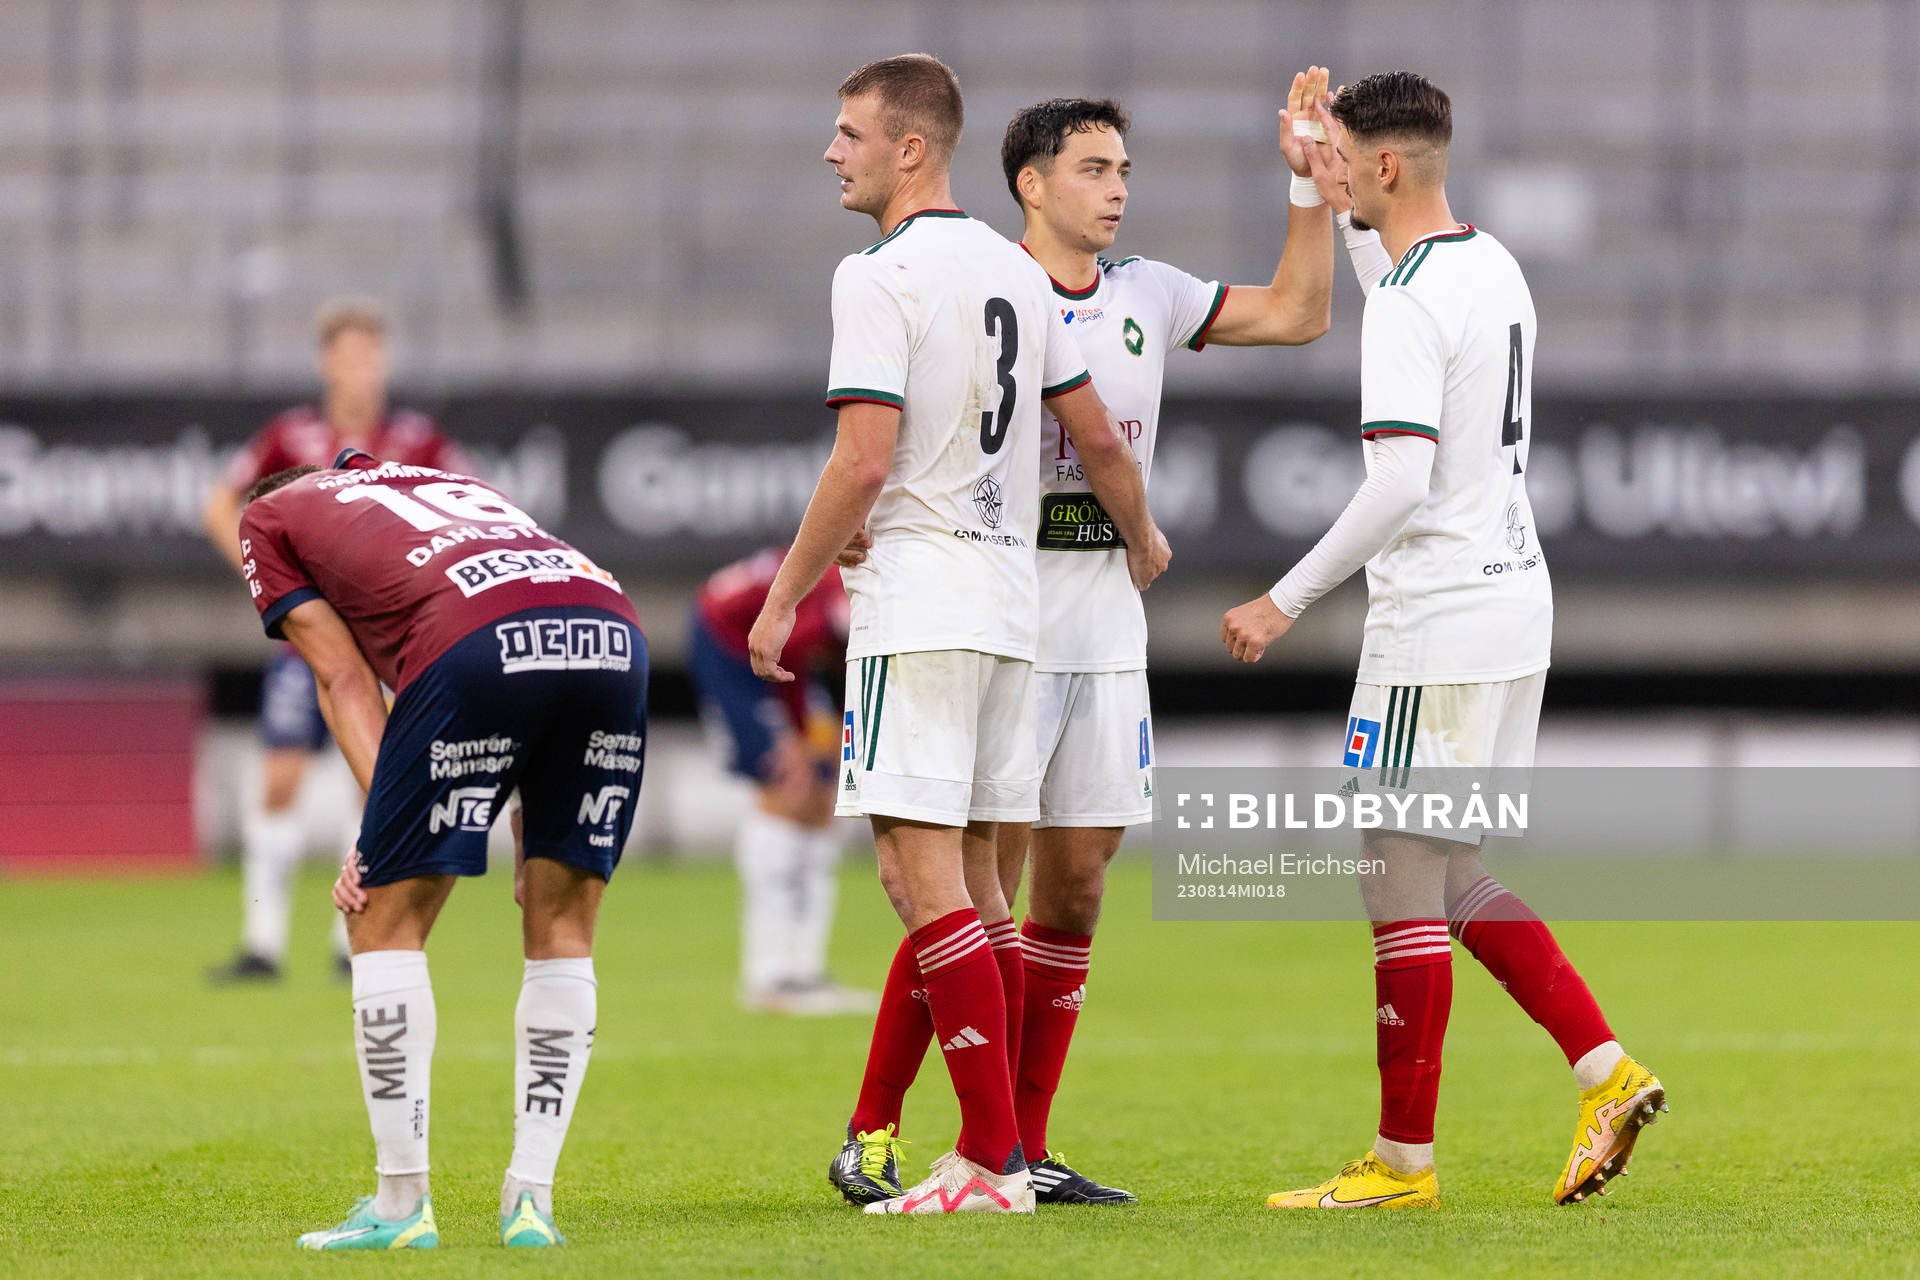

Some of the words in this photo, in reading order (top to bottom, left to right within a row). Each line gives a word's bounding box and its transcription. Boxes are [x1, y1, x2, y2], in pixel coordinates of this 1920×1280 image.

[980, 297, 1018, 455] 3
[1501, 322, 1523, 475] 4
[335, 482, 538, 533] 16
[405, 524, 566, 568] DAHLST
[1076, 523, 1113, 542] HUS
[456, 552, 574, 588] BESAB
[430, 732, 512, 760] Semrén
[1052, 998, 1083, 1011] adid
[1376, 1017, 1405, 1027] idas
[361, 1003, 407, 1100] MIKE
[525, 1027, 575, 1116] MIKE
